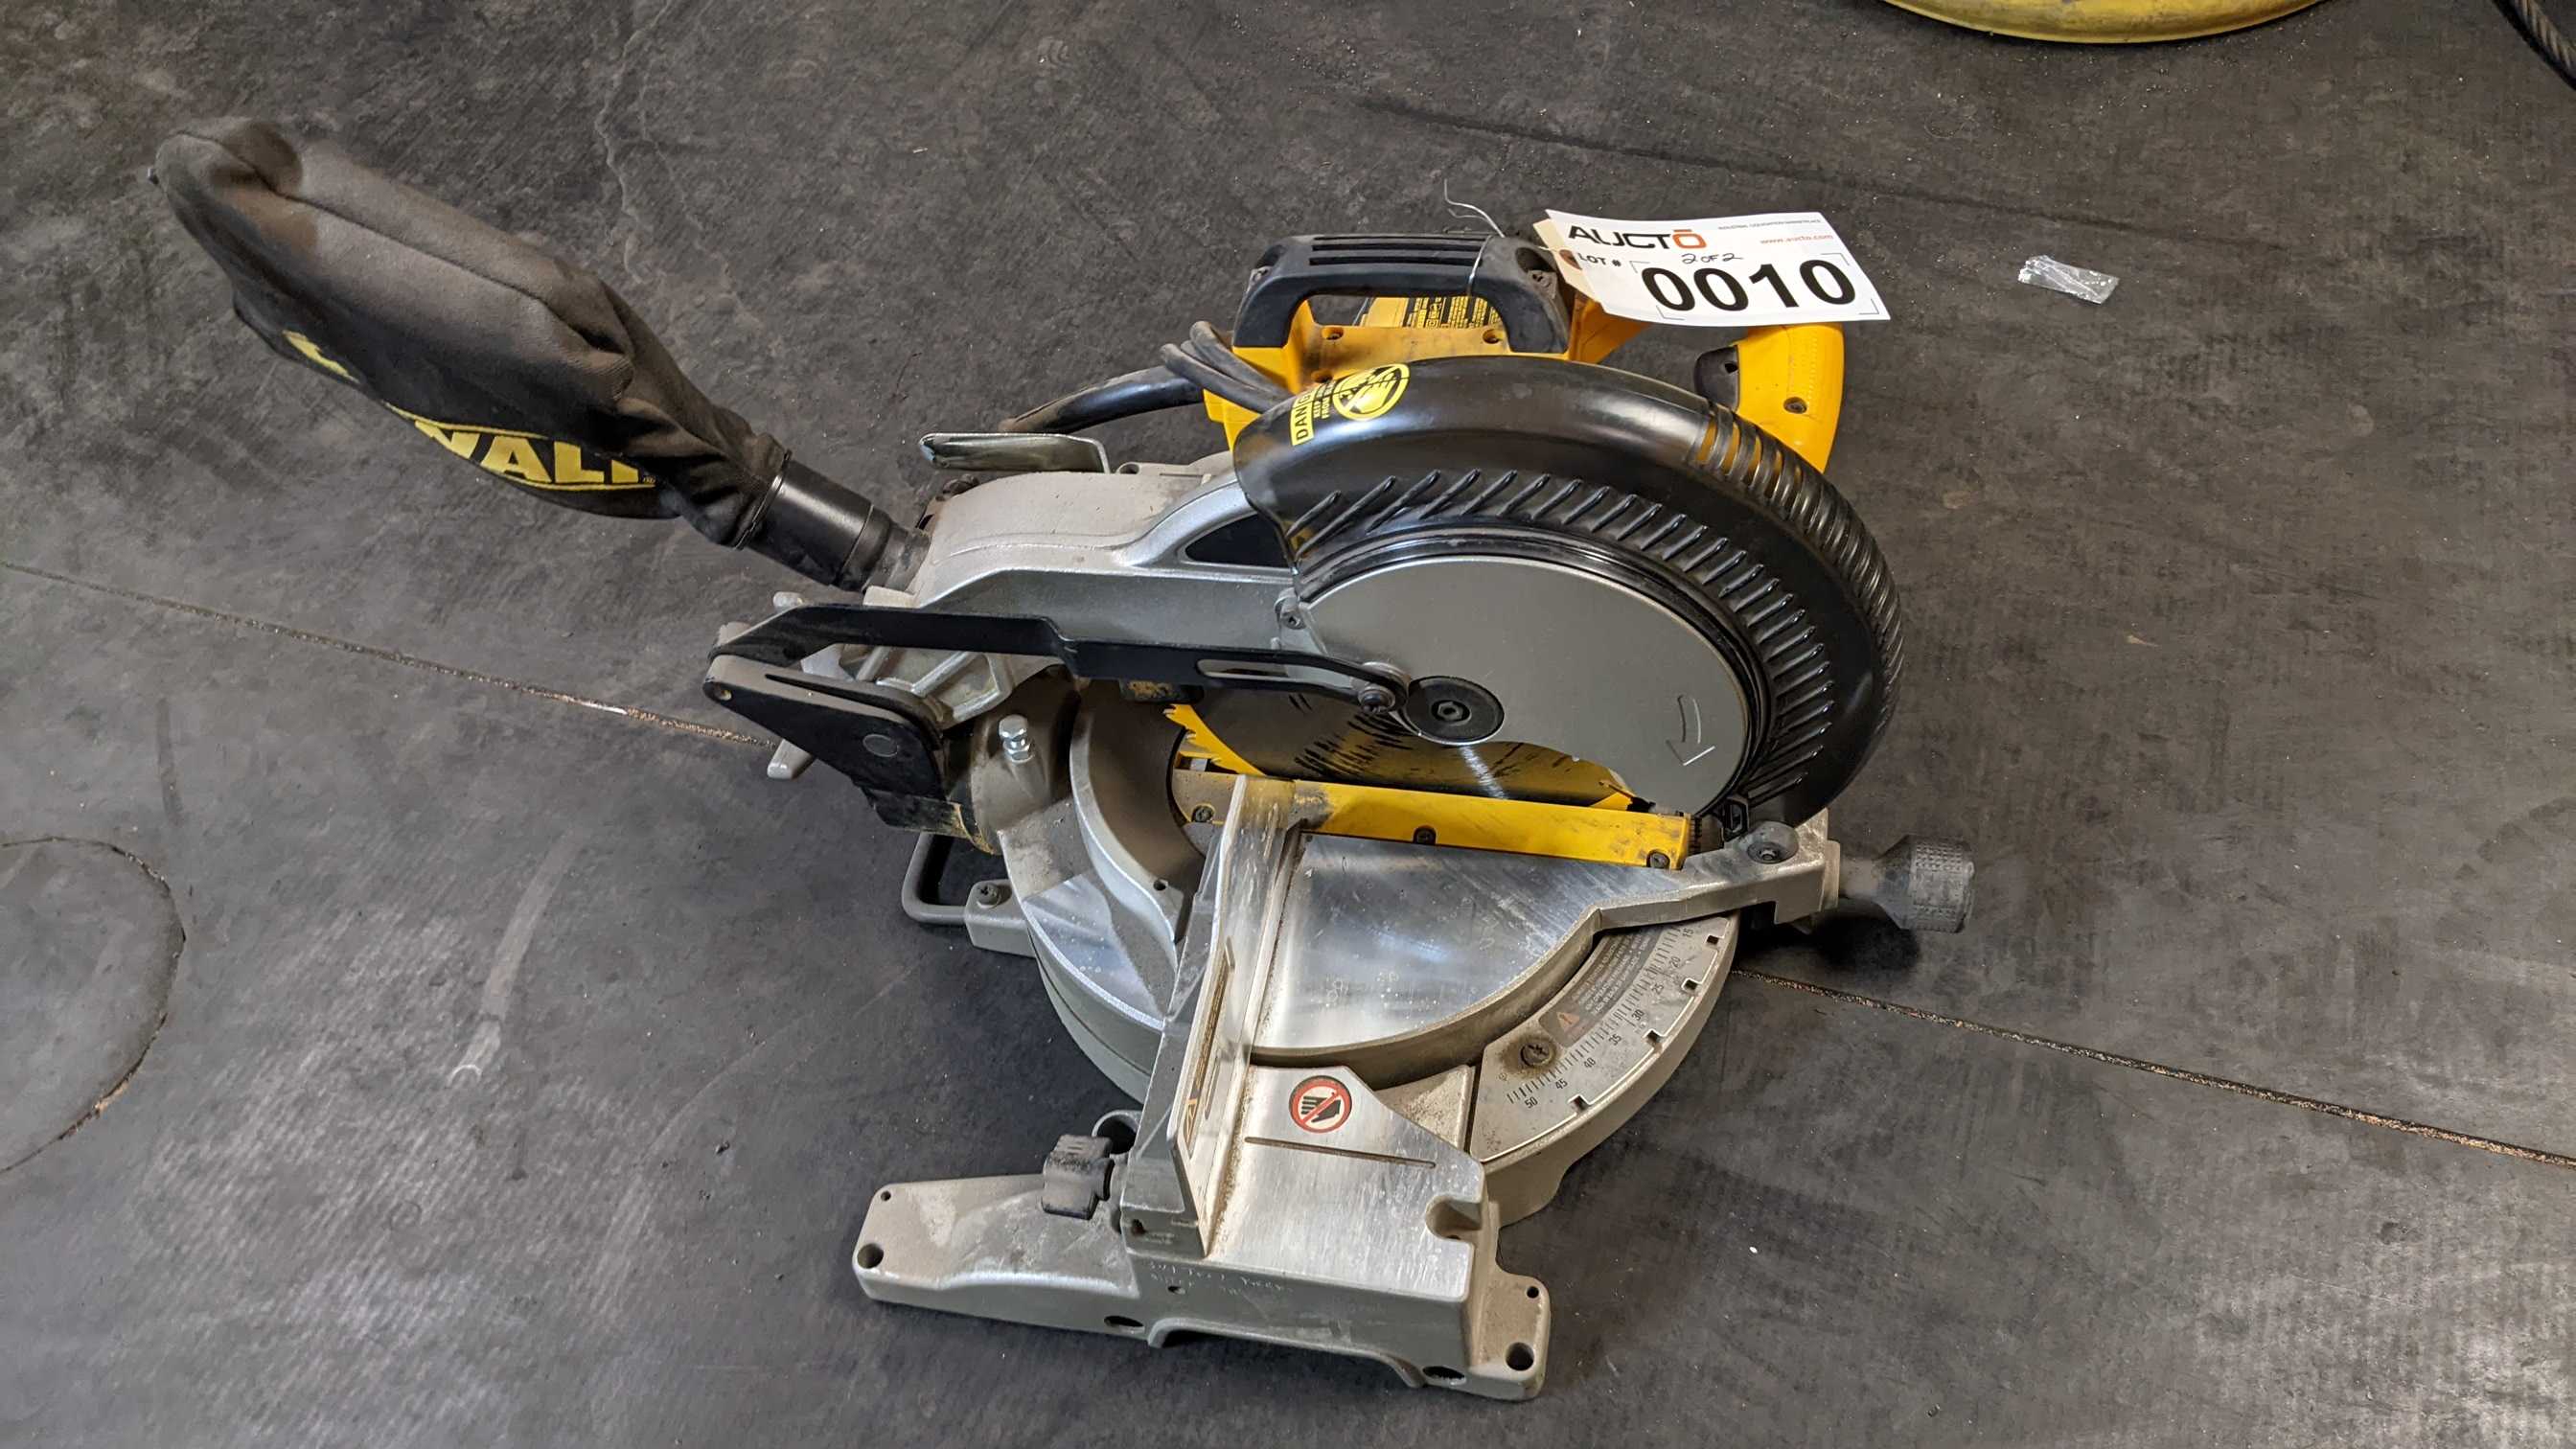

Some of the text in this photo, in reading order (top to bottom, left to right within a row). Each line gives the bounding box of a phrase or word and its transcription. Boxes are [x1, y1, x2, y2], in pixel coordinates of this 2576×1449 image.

[1579, 252, 1622, 267] LOT #
[1681, 253, 1699, 264] 2
[1722, 252, 1744, 262] 2
[1641, 260, 1856, 311] 0010
[1295, 390, 1310, 440] DANG
[1524, 1096, 1538, 1109] 50
[1554, 1078, 1568, 1090] 45
[1583, 1057, 1596, 1069] 40
[1608, 1033, 1622, 1046] 35
[1631, 1009, 1644, 1022] 30
[1651, 982, 1664, 995] 25
[1668, 956, 1681, 968] 20
[1682, 928, 1693, 938] 15
